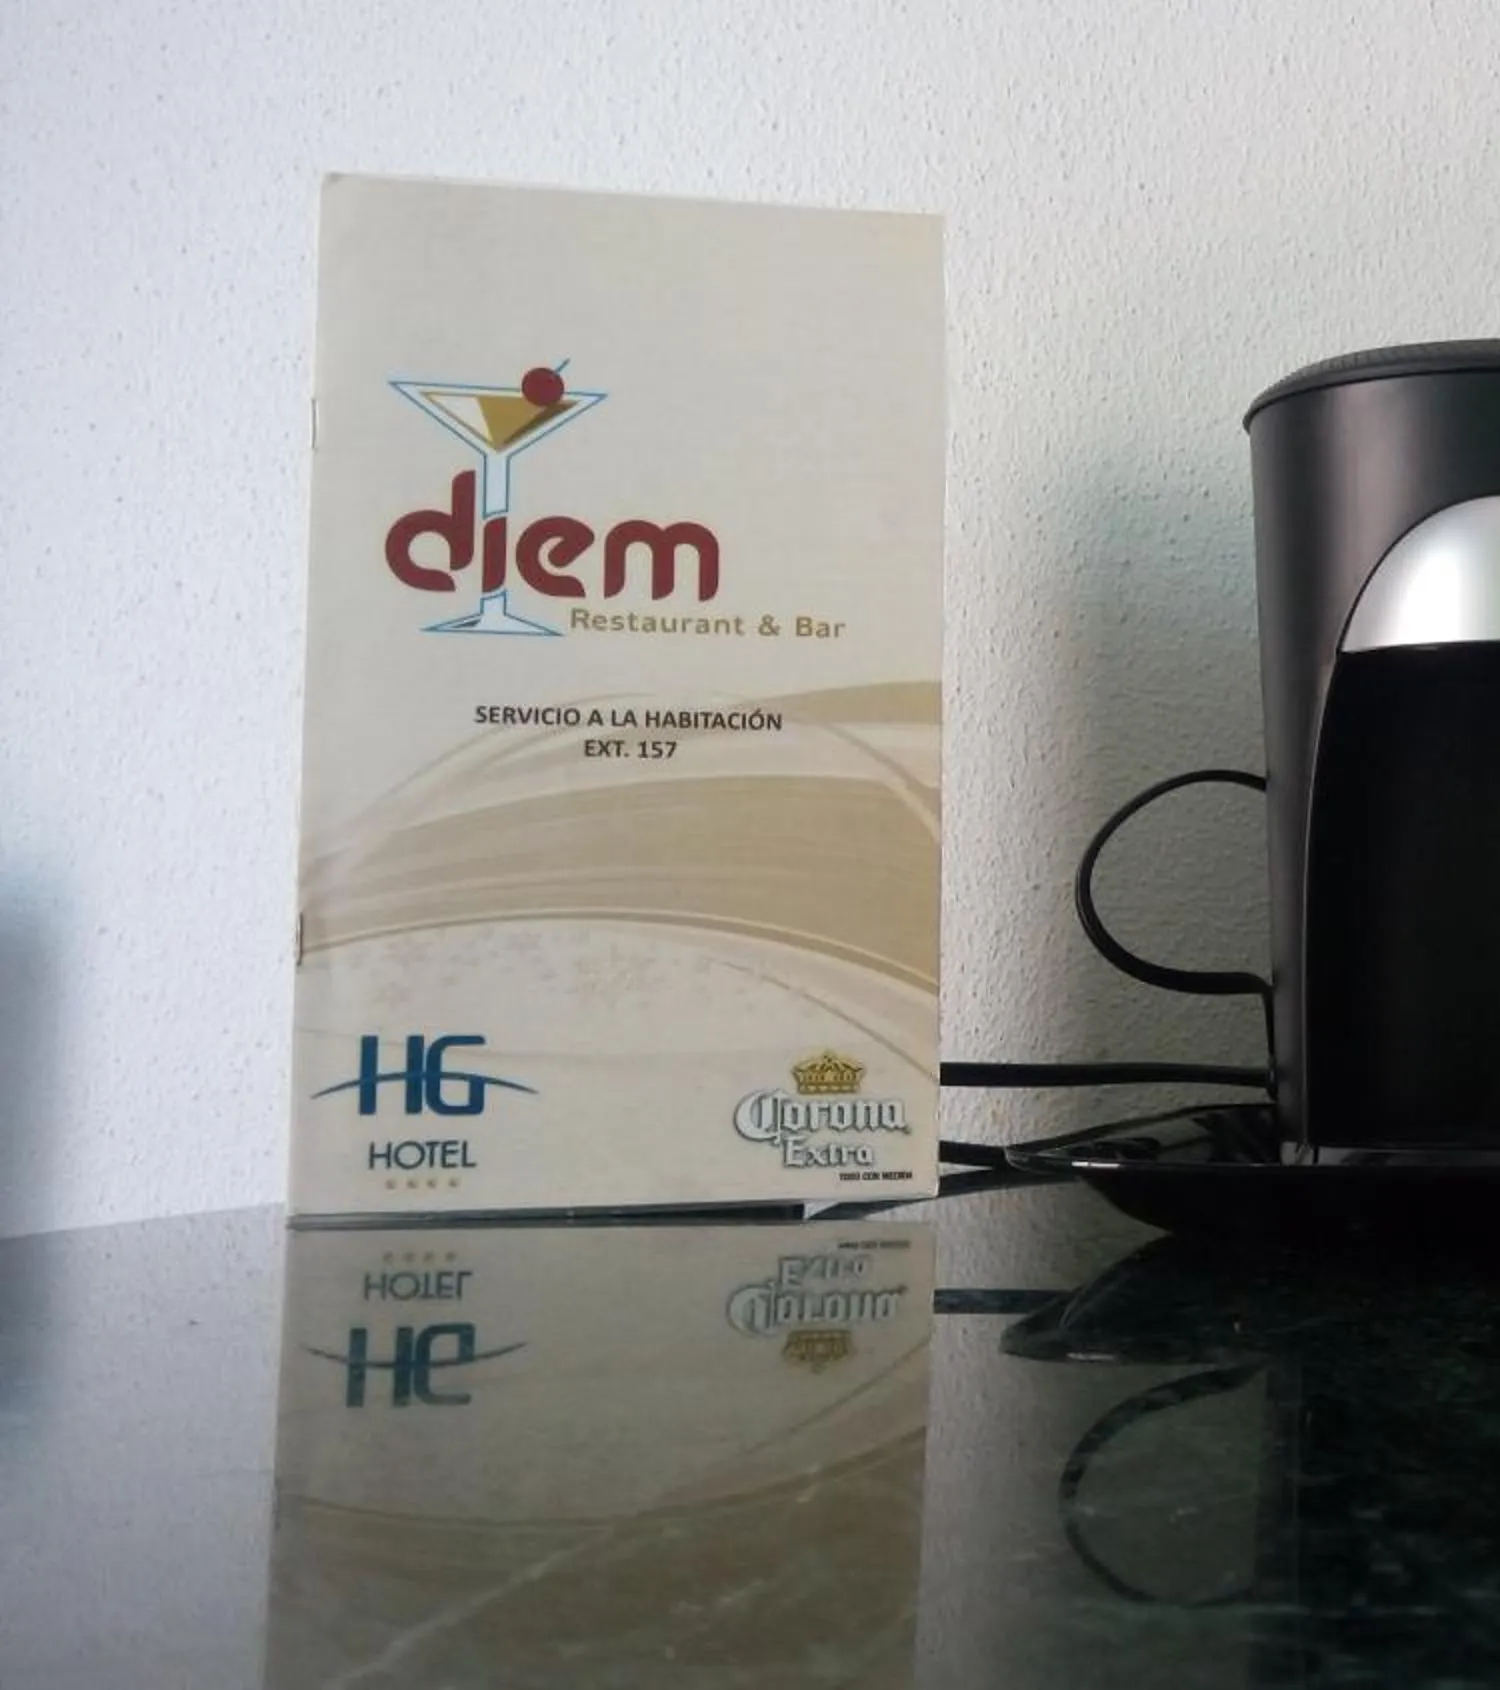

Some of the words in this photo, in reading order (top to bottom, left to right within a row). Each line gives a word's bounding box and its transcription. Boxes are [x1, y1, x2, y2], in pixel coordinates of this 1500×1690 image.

[385, 469, 721, 603] diem
[570, 607, 746, 637] Restaurant
[758, 615, 781, 638] &
[795, 615, 846, 639] Bar
[475, 705, 582, 728] SERVICIO
[588, 708, 603, 728] A
[611, 708, 638, 729] LA
[645, 708, 783, 732] HABITACIÓN
[584, 740, 630, 759] EXT.
[637, 740, 677, 759] 157
[358, 1035, 486, 1116] HG
[733, 1089, 911, 1145] Corona
[368, 1140, 477, 1170] HOTEL
[781, 1137, 874, 1169] Extra
